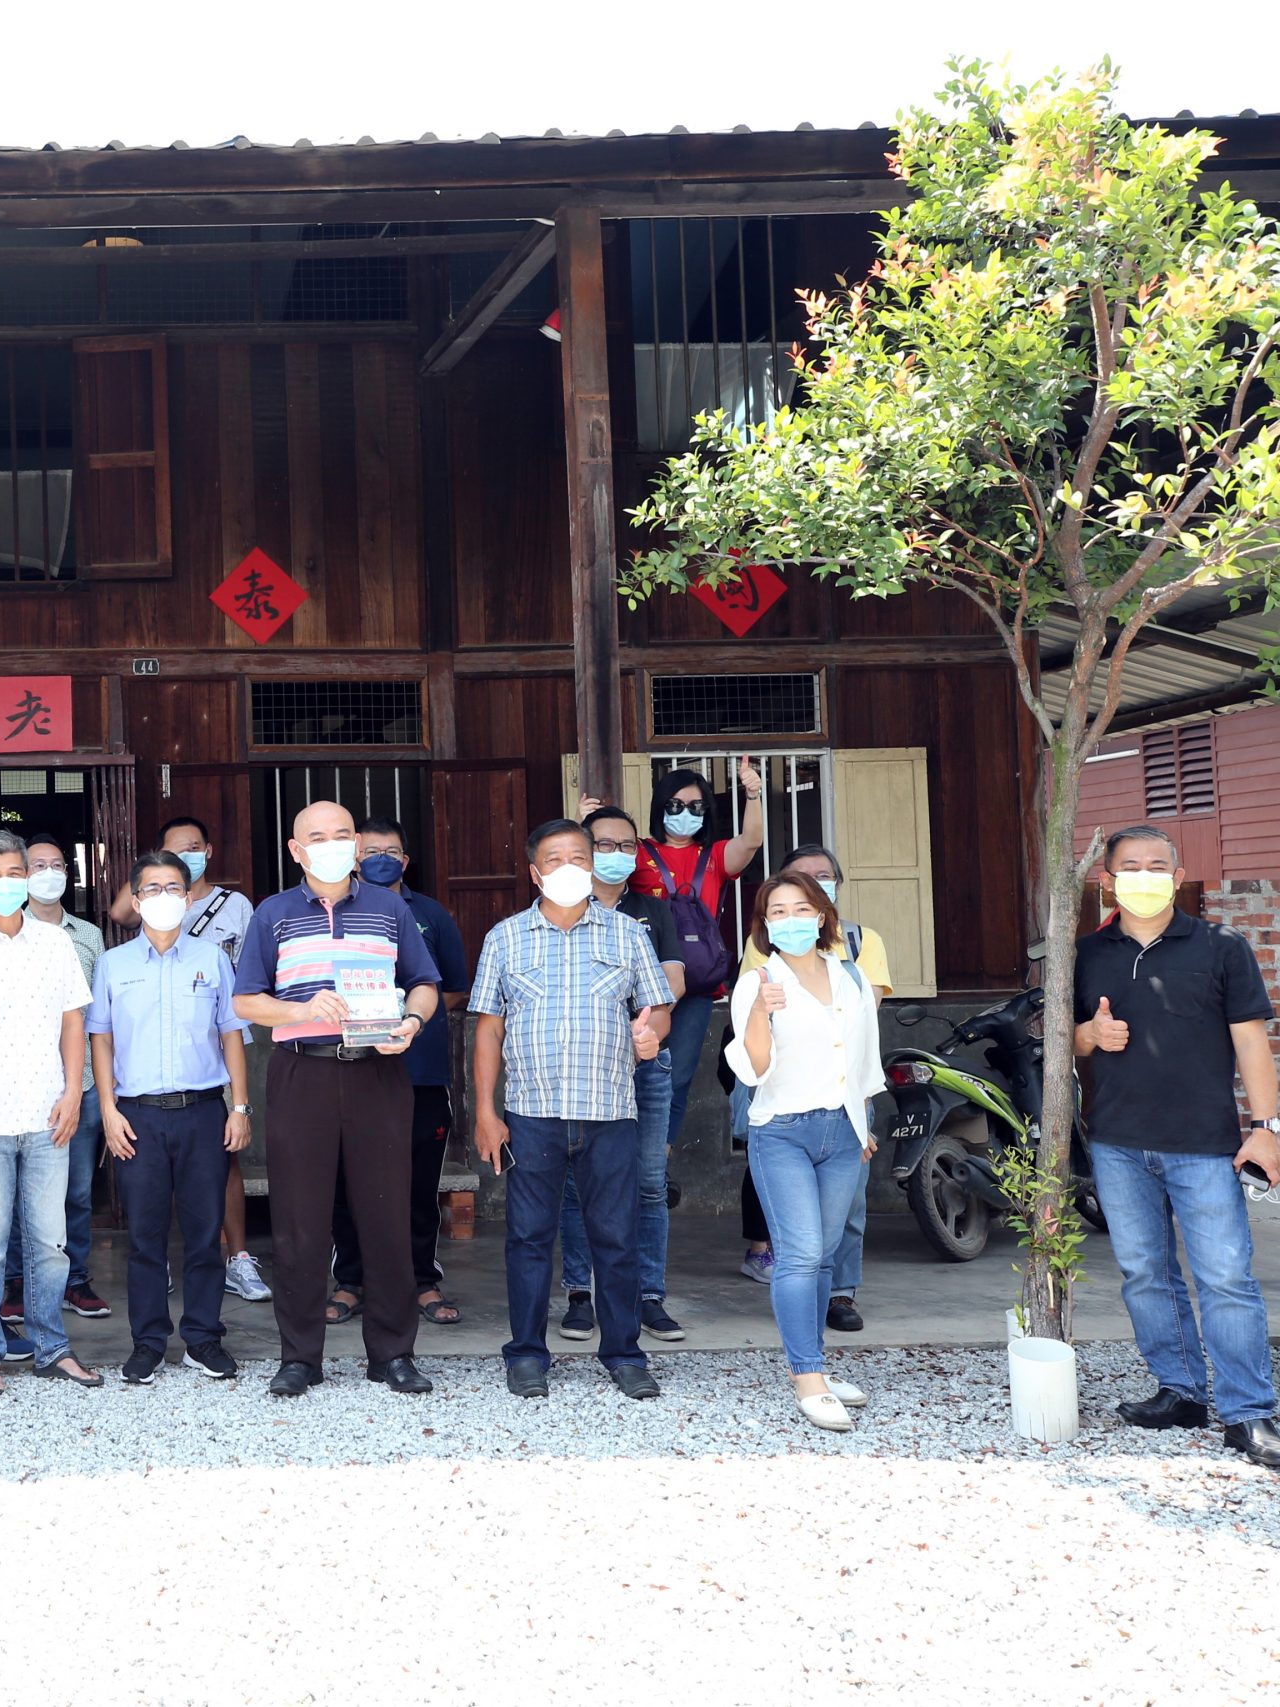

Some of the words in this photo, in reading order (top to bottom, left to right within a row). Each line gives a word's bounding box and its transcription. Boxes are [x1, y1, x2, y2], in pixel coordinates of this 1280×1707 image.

[233, 569, 280, 620] 泰
[906, 1114, 915, 1124] V
[891, 1124, 924, 1138] 4271
